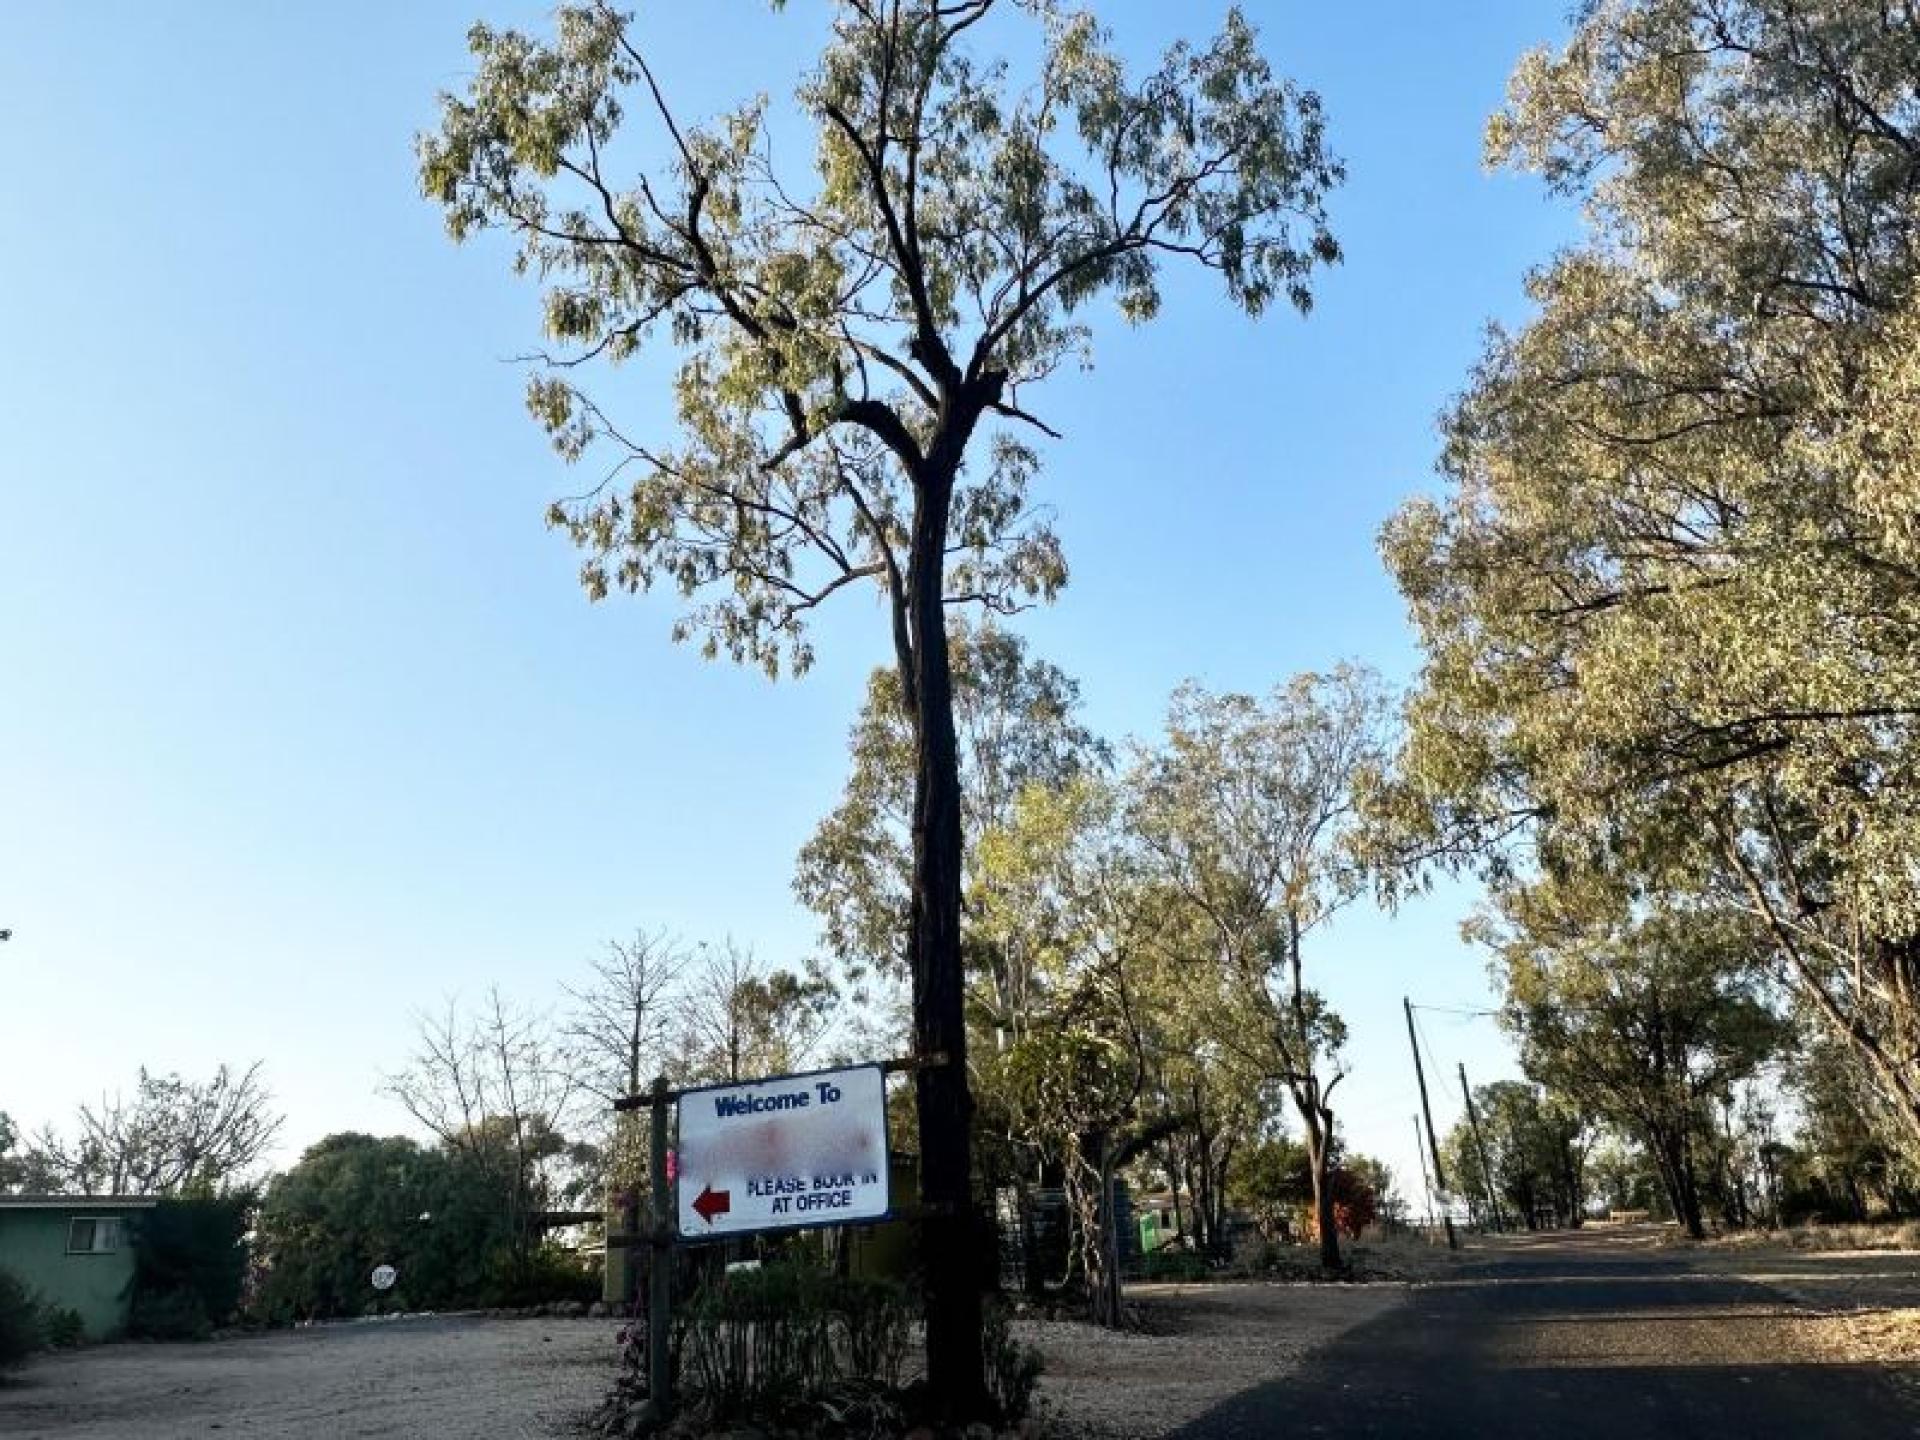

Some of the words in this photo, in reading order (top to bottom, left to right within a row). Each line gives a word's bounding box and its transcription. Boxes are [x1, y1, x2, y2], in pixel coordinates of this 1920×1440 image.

[715, 1092, 809, 1117] Welcome
[816, 1082, 841, 1104] To
[748, 1178, 806, 1197] PLEASE
[772, 1196, 793, 1214] AT
[796, 1189, 852, 1211] OFFICE
